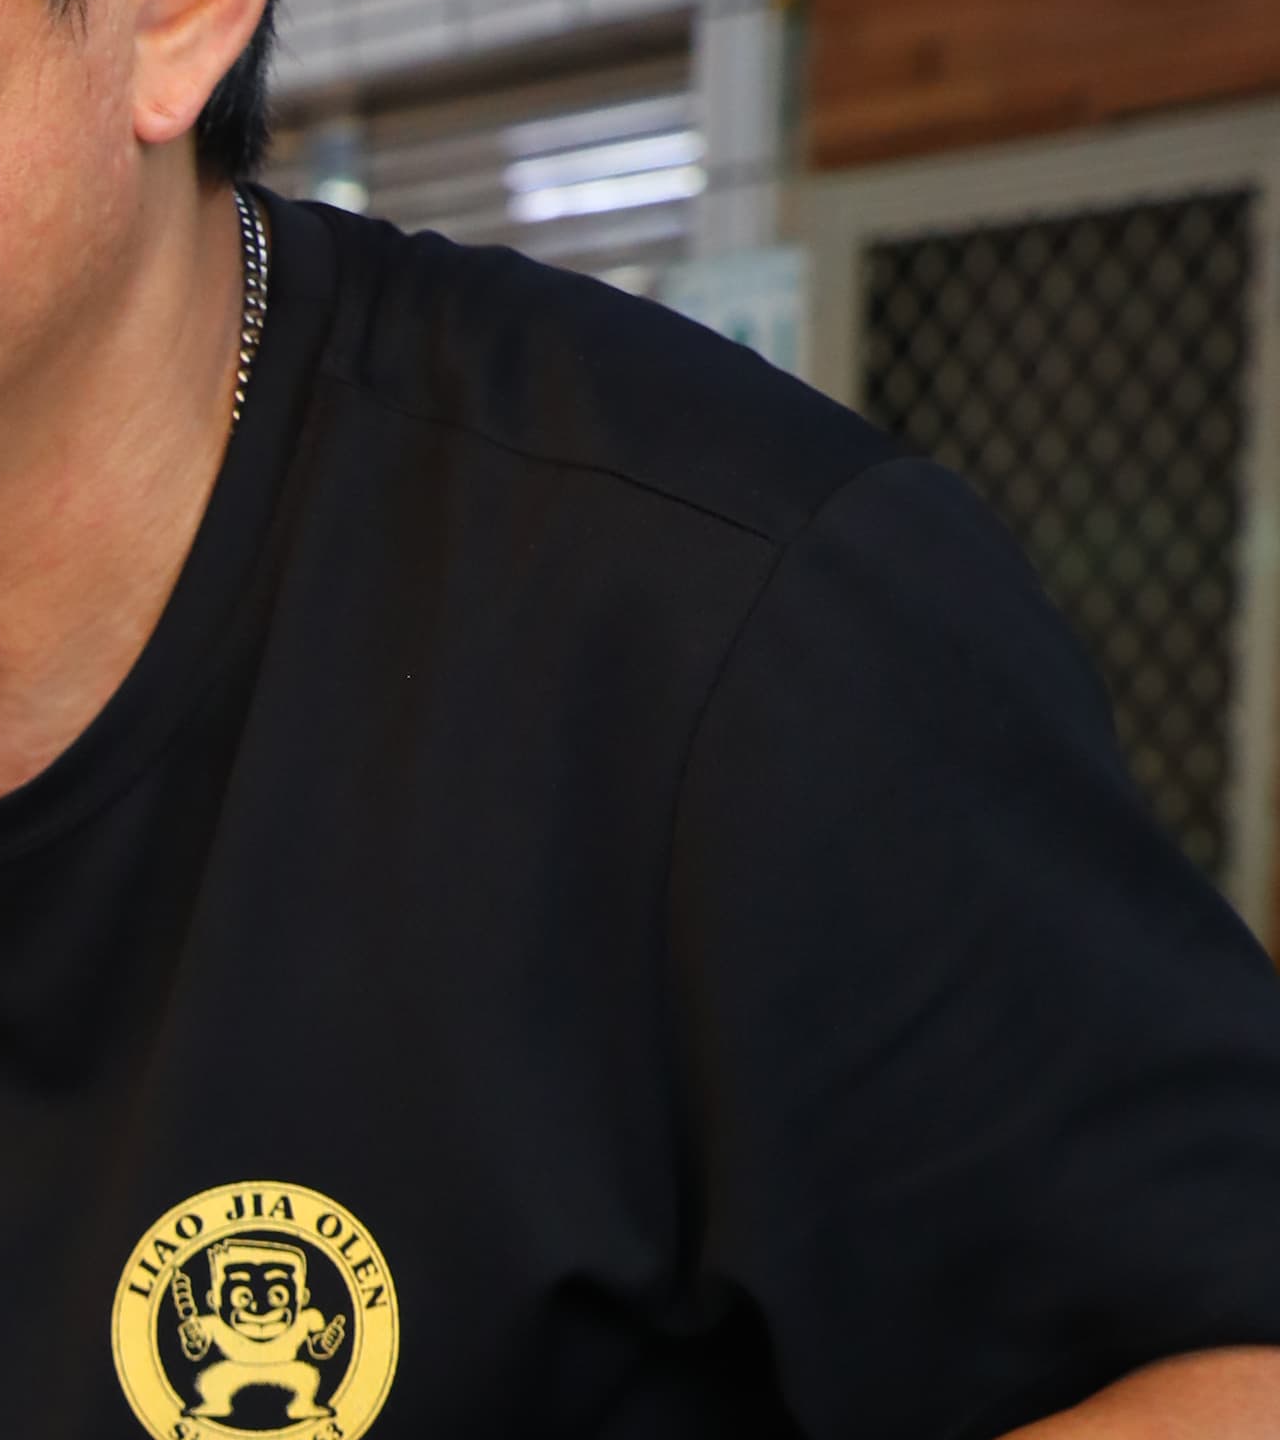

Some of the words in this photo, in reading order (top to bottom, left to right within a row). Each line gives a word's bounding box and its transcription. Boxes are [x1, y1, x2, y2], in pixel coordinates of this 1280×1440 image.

[128, 1213, 203, 1299] LIAO
[225, 1193, 295, 1221] JIA
[316, 1213, 387, 1310] OLEN
